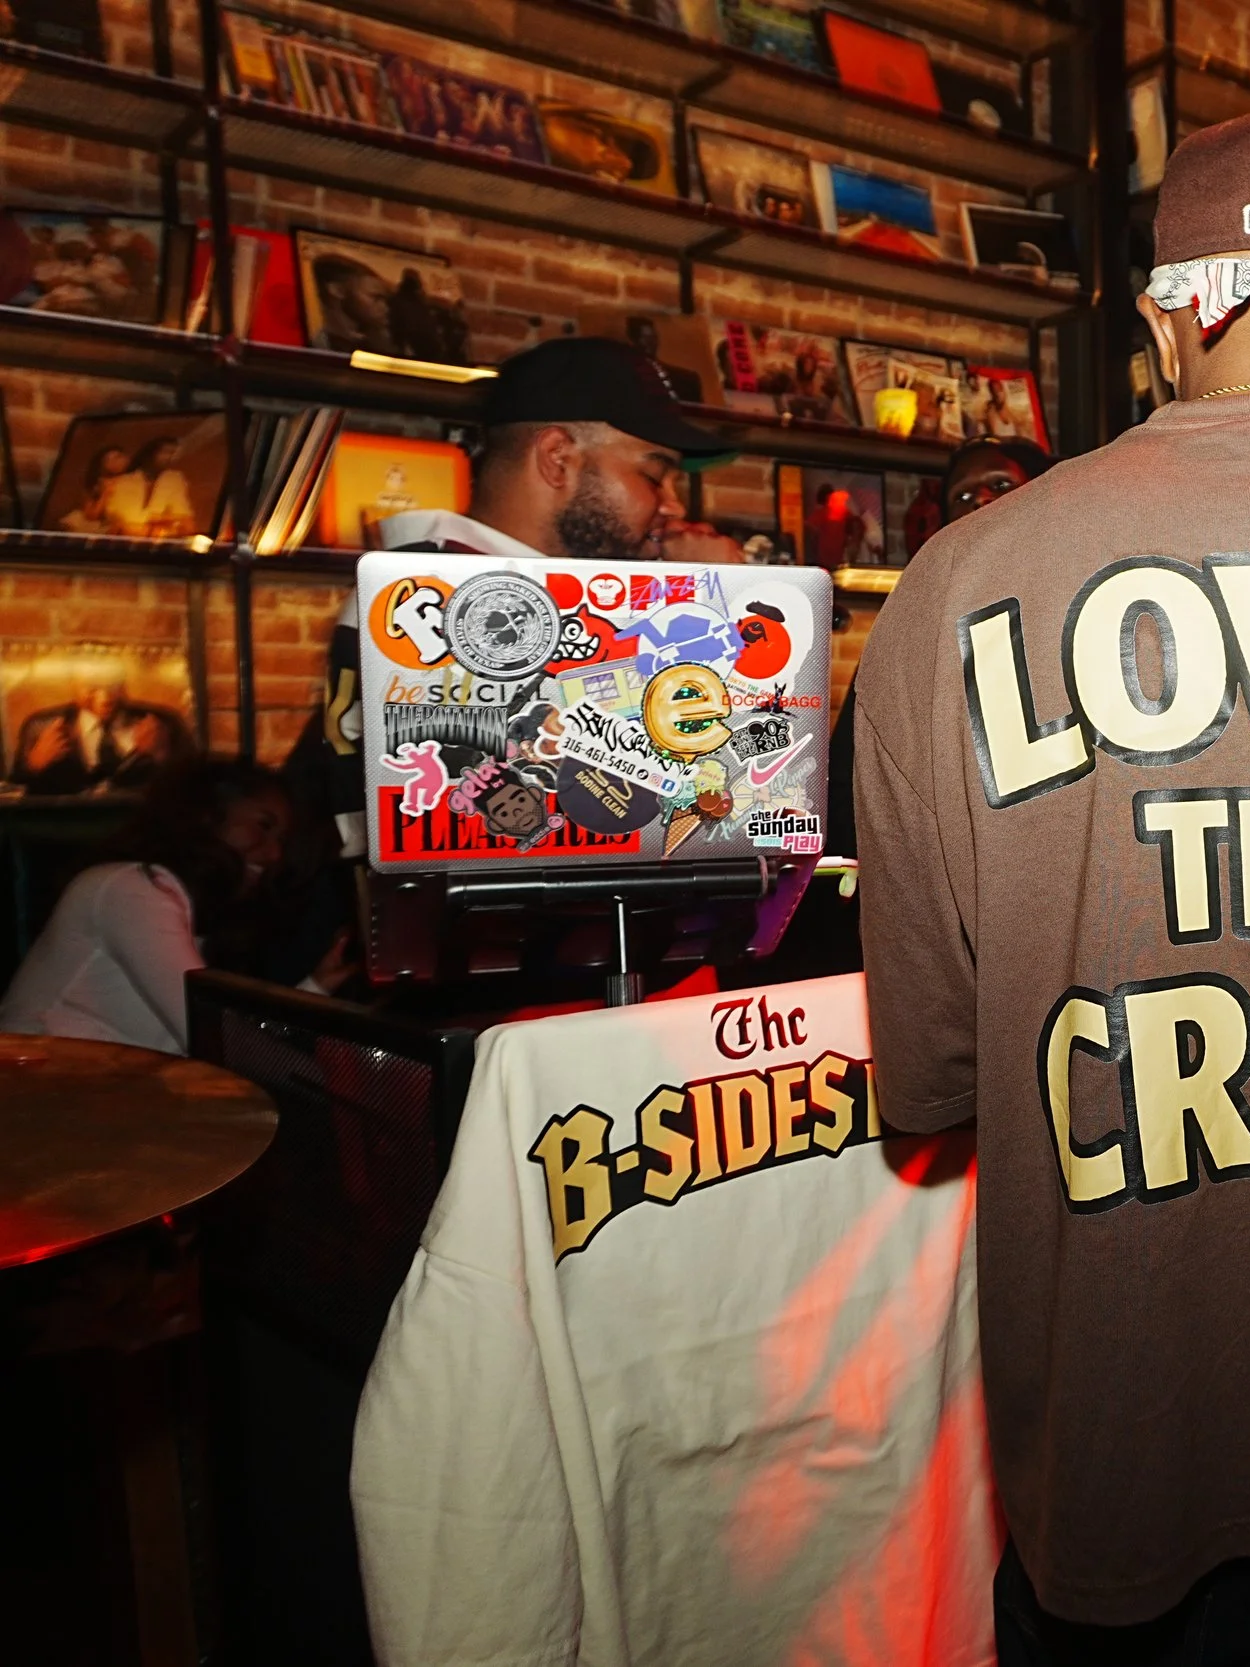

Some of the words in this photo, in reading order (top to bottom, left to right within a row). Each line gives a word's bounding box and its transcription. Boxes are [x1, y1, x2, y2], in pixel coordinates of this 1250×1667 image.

[546, 573, 695, 611] DOPE
[779, 695, 822, 710] BAGG
[562, 736, 636, 776] 316-461-5450
[575, 770, 606, 799] BODINE
[601, 795, 628, 819] CLEAN
[751, 810, 771, 821] the
[711, 995, 808, 1060] The
[528, 1051, 856, 1269] B-SIDES
